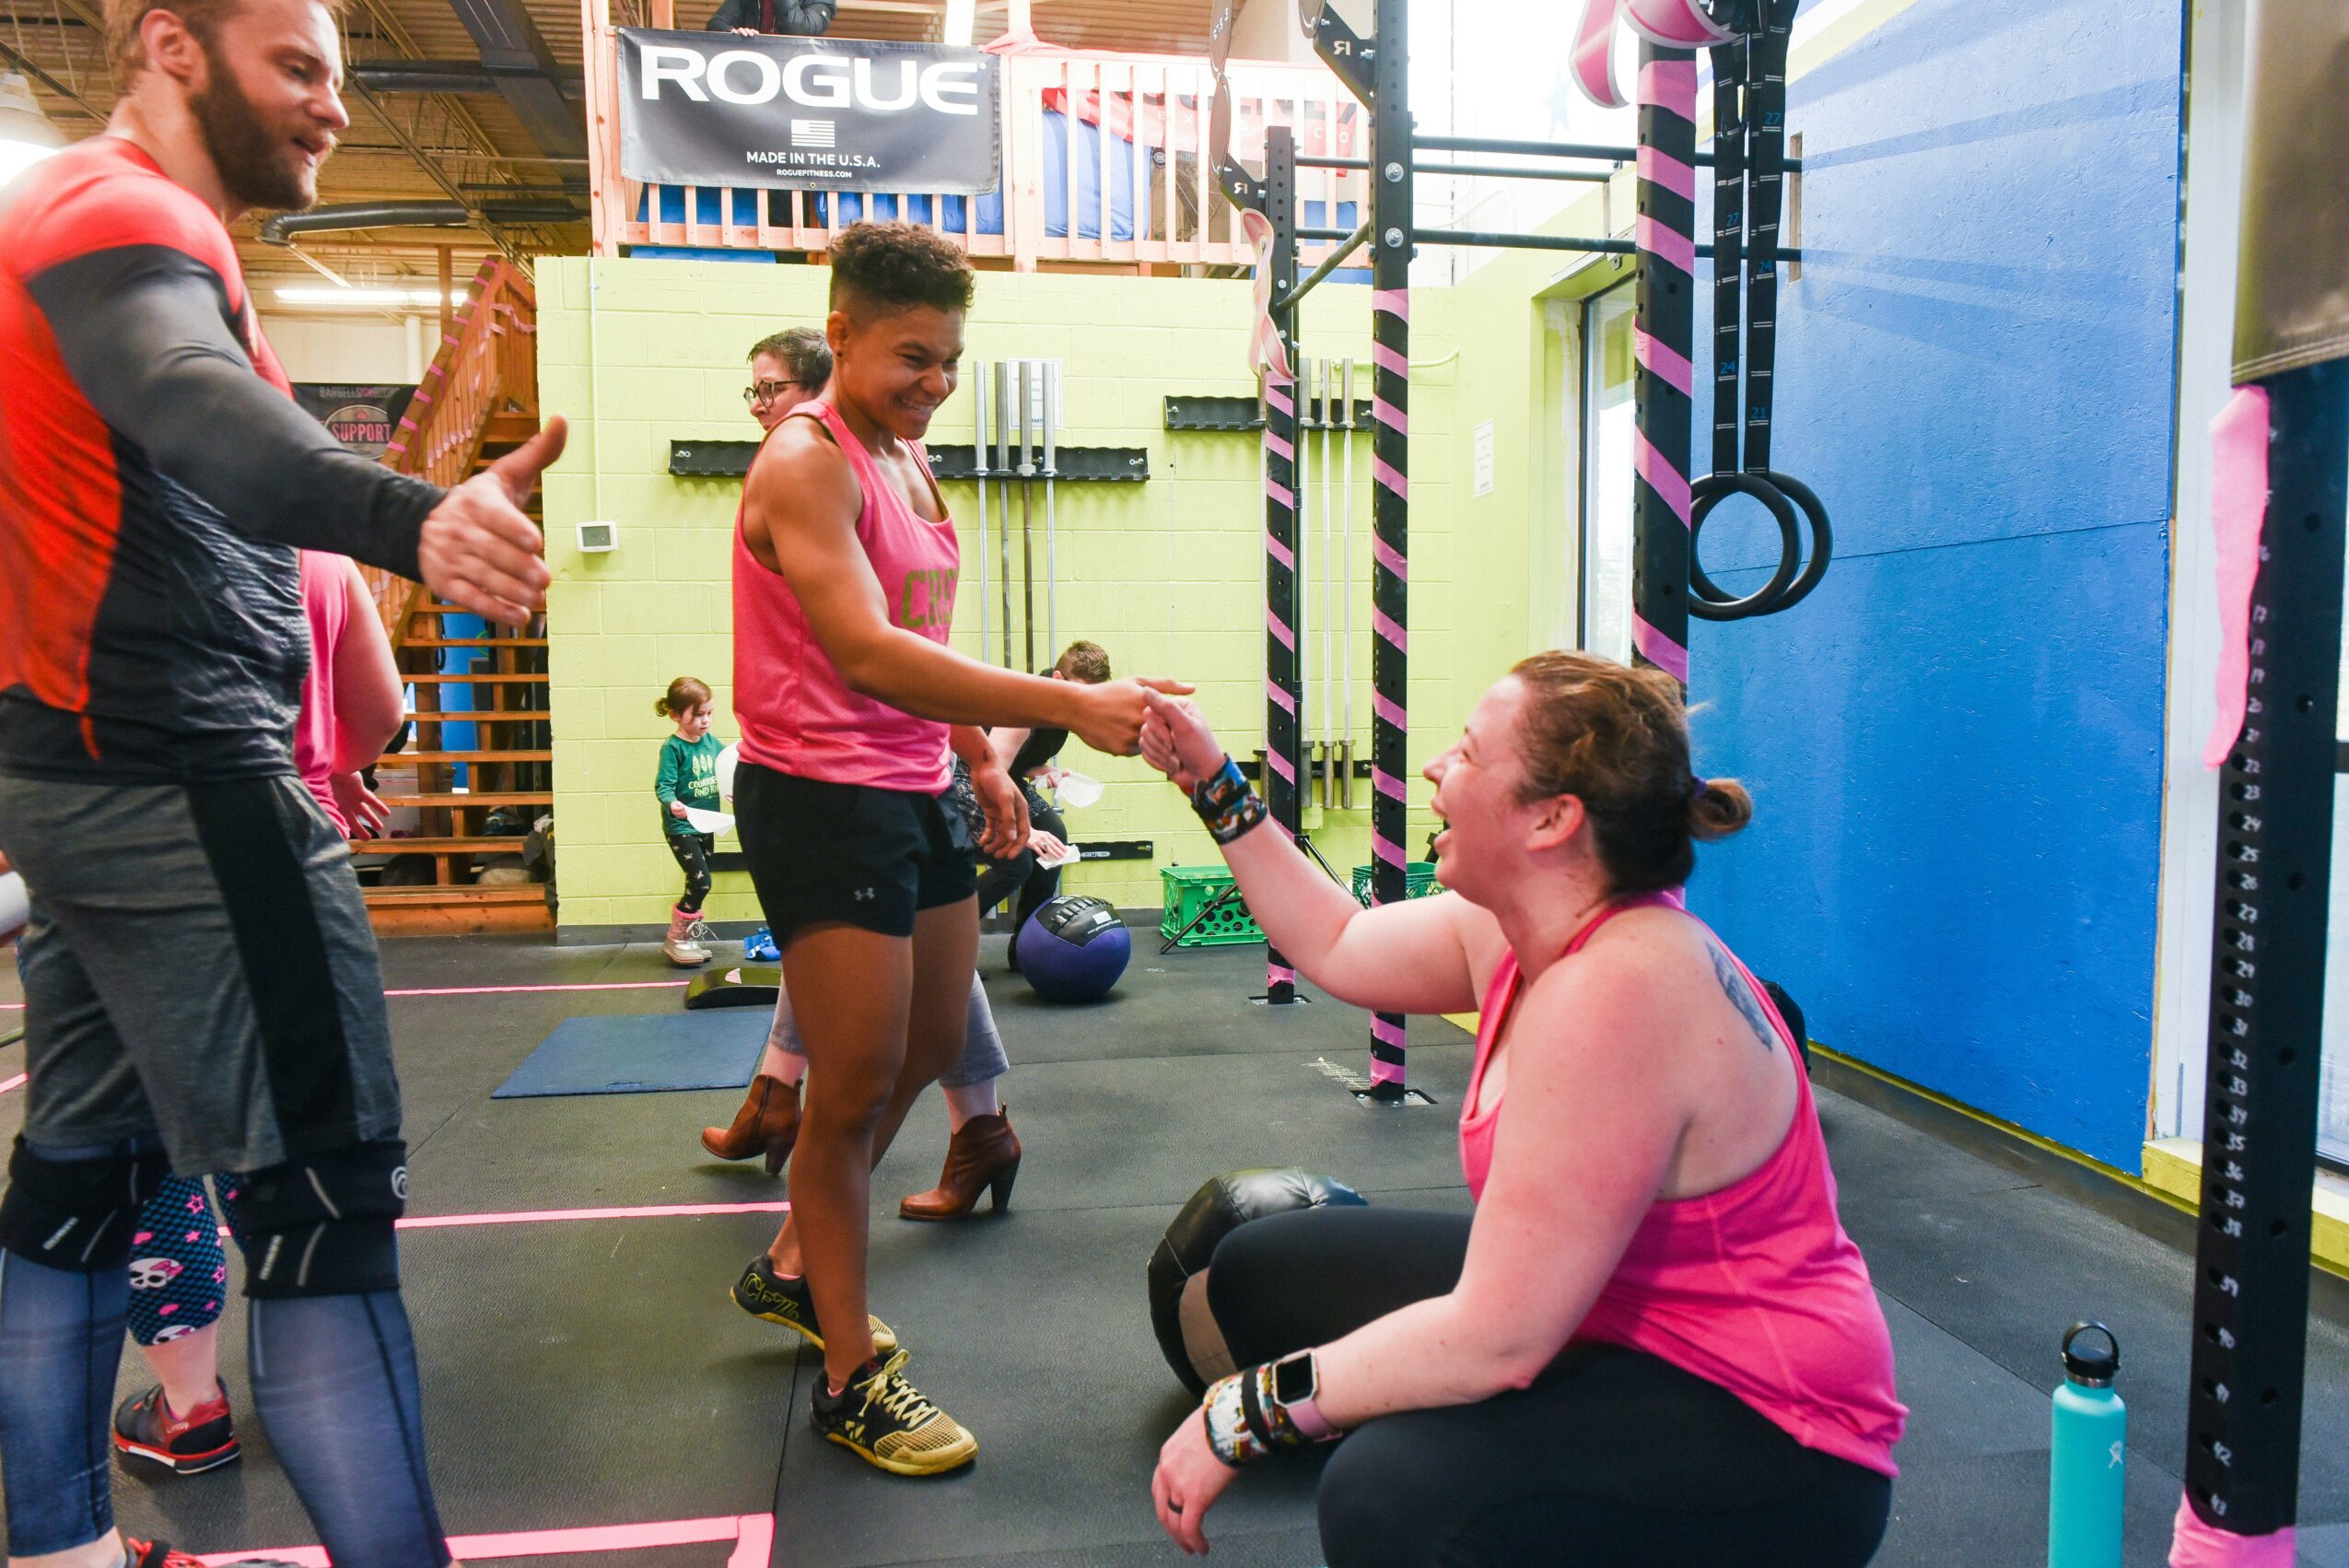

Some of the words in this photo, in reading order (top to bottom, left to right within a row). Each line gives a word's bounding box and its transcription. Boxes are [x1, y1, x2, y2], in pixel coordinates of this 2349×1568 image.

[640, 44, 978, 115] ROGUE
[1766, 112, 1781, 124] 27
[746, 151, 787, 164] MADE
[789, 153, 804, 164] IN
[808, 153, 836, 166] THE
[838, 155, 881, 168] U.S.A.
[777, 169, 852, 178] ROGUEFITNESS.COM
[1727, 213, 1739, 227] 27
[1759, 260, 1773, 273] 24
[1720, 361, 1735, 374] 24
[1752, 406, 1767, 419] 21
[332, 423, 392, 442] SUPPORT
[2248, 696, 2262, 713] 20
[2244, 758, 2261, 774] 22
[694, 785, 710, 798] AND
[2244, 784, 2261, 801] 23
[2242, 814, 2261, 832] 24
[2240, 845, 2260, 862] 25
[2240, 873, 2258, 890] 26
[2238, 903, 2258, 924] 27
[2237, 959, 2256, 978] 29
[2235, 989, 2253, 1007] 30
[2230, 1048, 2248, 1071] 32
[2229, 1075, 2248, 1096] 33
[2229, 1105, 2248, 1125] 34
[2226, 1131, 2247, 1151] 35
[2226, 1188, 2245, 1210] 37
[2220, 1275, 2238, 1298] 39
[2213, 1441, 2232, 1468] 42
[2211, 1493, 2227, 1516] 43
